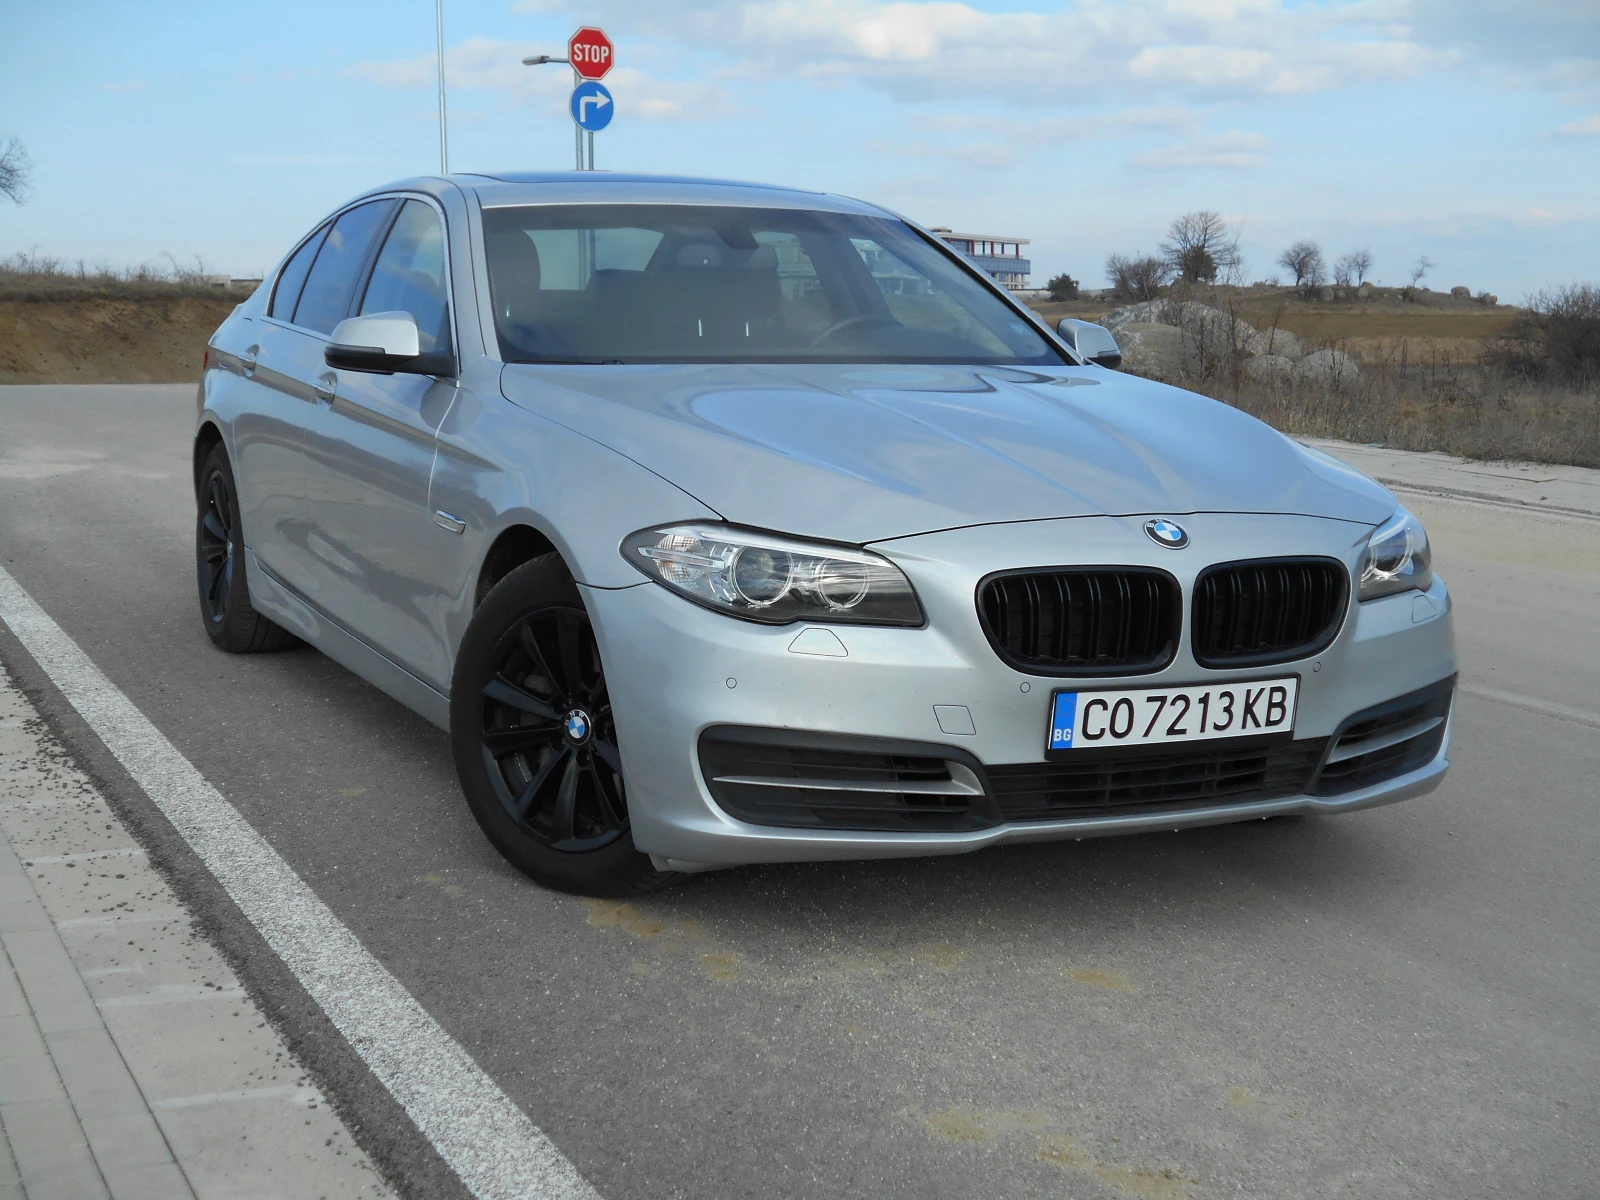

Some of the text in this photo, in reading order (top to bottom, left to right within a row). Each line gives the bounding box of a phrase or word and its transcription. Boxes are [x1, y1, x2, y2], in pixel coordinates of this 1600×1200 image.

[573, 43, 609, 63] STOP
[1142, 690, 1235, 738] 7213
[1241, 685, 1288, 730] KB
[1053, 728, 1072, 742] BG
